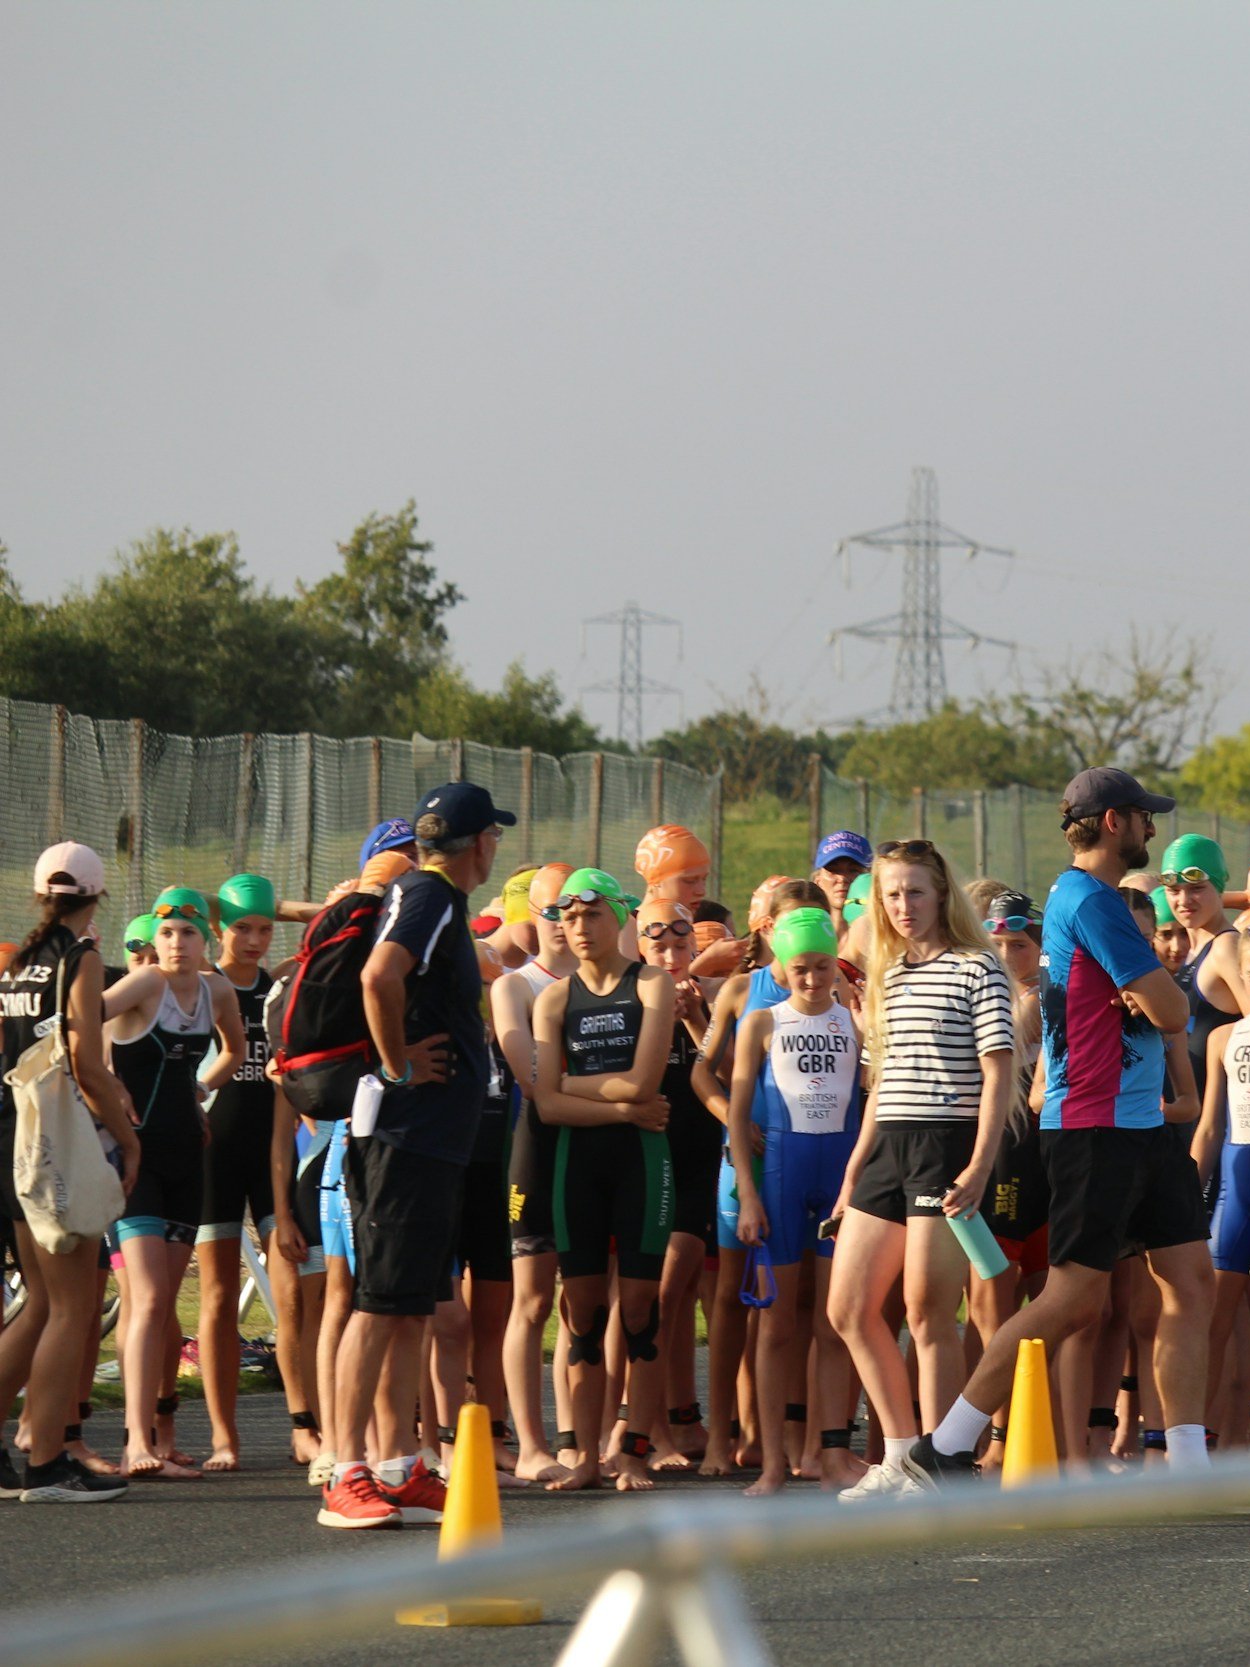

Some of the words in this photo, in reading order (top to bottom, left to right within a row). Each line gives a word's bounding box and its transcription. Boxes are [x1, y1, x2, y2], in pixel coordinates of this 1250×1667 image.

[828, 832, 861, 843] SOUTH
[822, 840, 865, 855] CENTRAL
[579, 1012, 626, 1035] GRIFFITHS
[571, 1041, 605, 1052] SOUTH
[607, 1036, 635, 1046] WEST
[781, 1034, 849, 1053] WOODLEY
[798, 1055, 836, 1073] GBR
[232, 1065, 265, 1082] GBR
[799, 1094, 838, 1102] BRITISH
[806, 1110, 831, 1119] EAST
[662, 1158, 670, 1187] WEST
[995, 1183, 1009, 1215] BIG
[659, 1190, 669, 1226] SOUTH
